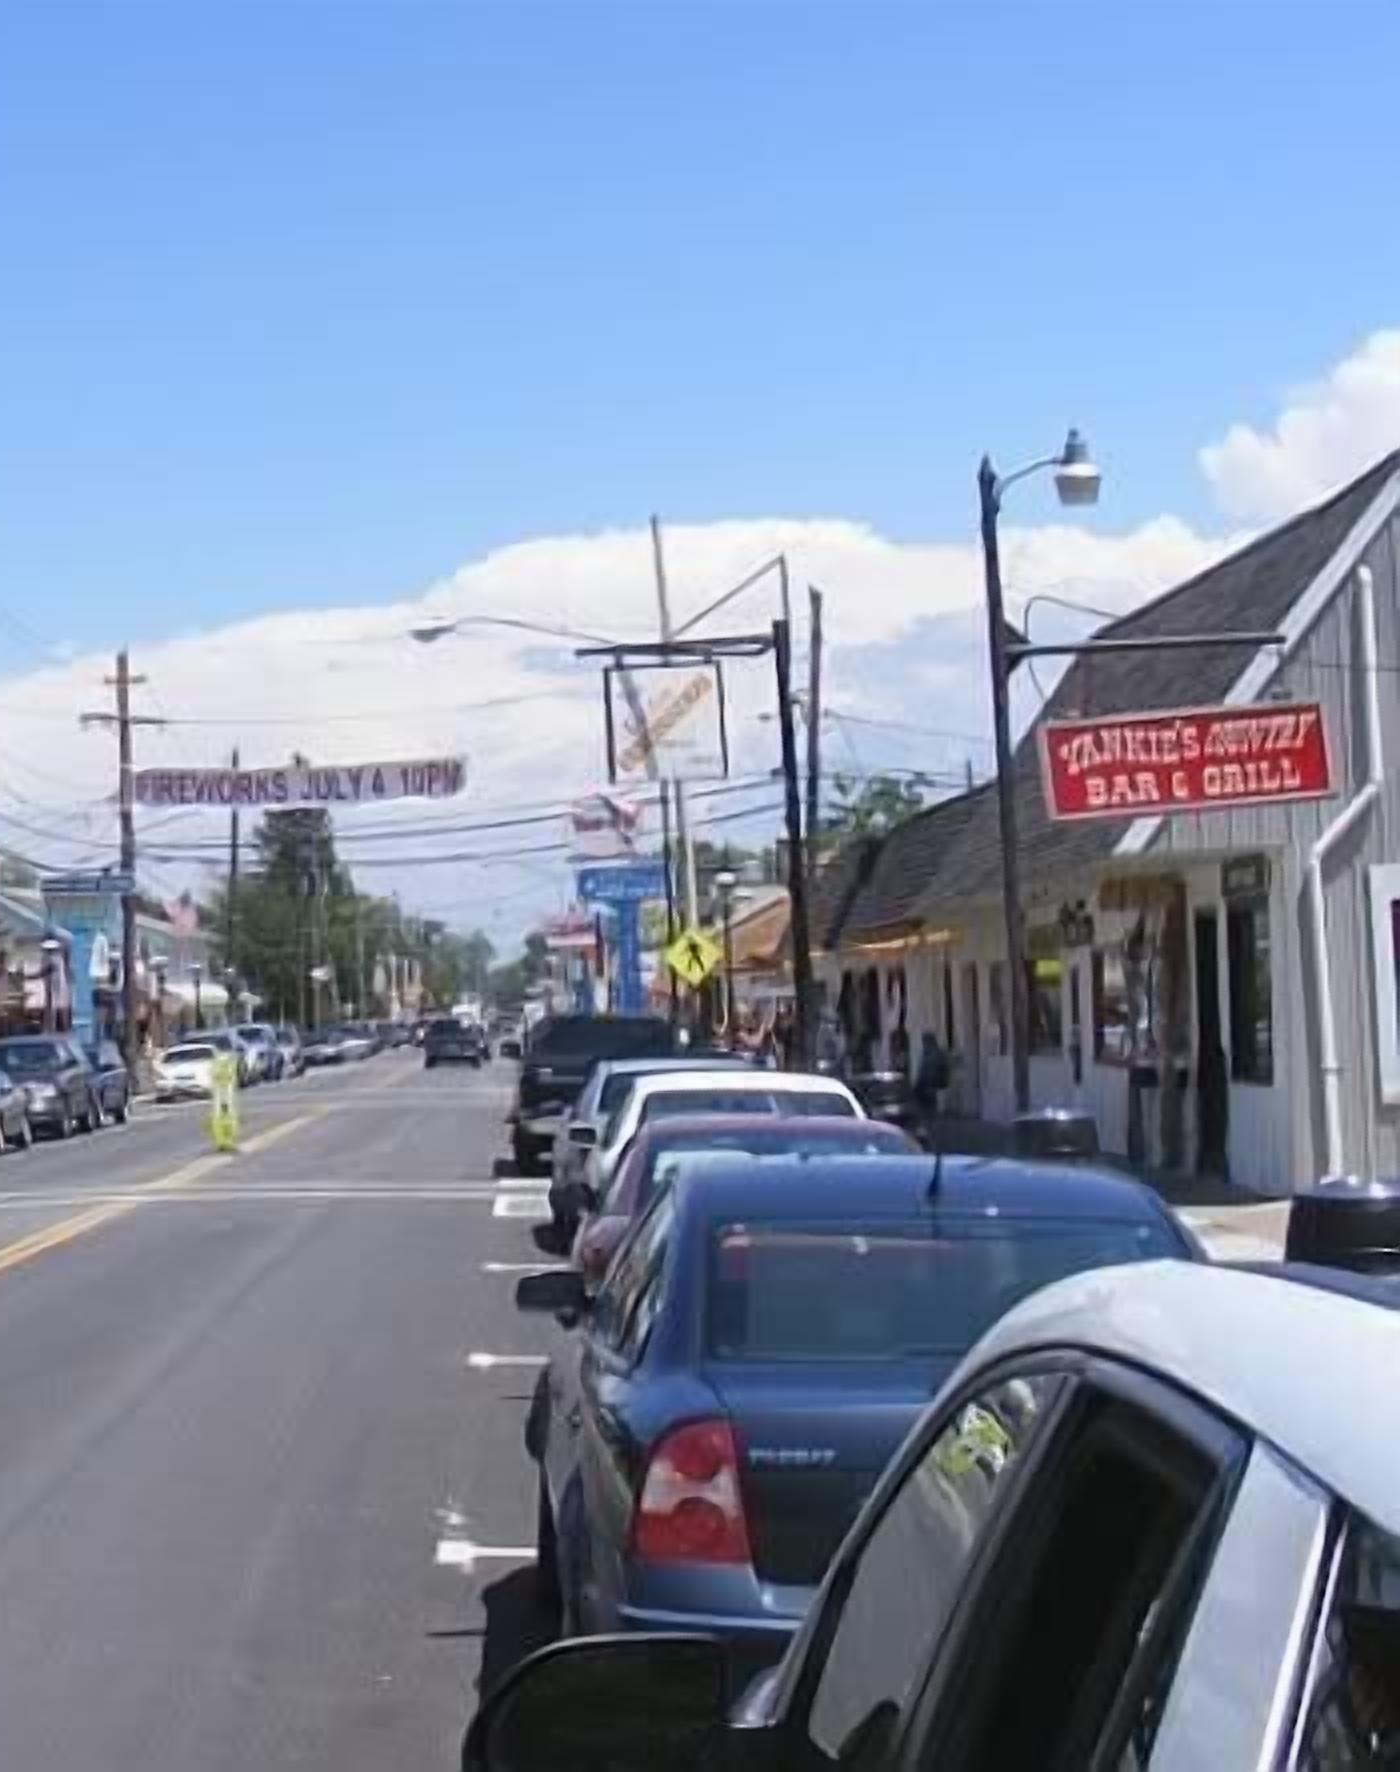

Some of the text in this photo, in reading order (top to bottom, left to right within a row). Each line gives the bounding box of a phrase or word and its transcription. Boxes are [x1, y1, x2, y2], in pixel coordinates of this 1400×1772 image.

[1058, 719, 1201, 776] YANKIE'S
[137, 769, 288, 805] FIREWORKS
[300, 767, 363, 801] JULY
[1084, 770, 1161, 807] BAR
[1202, 757, 1301, 797] GRILL
